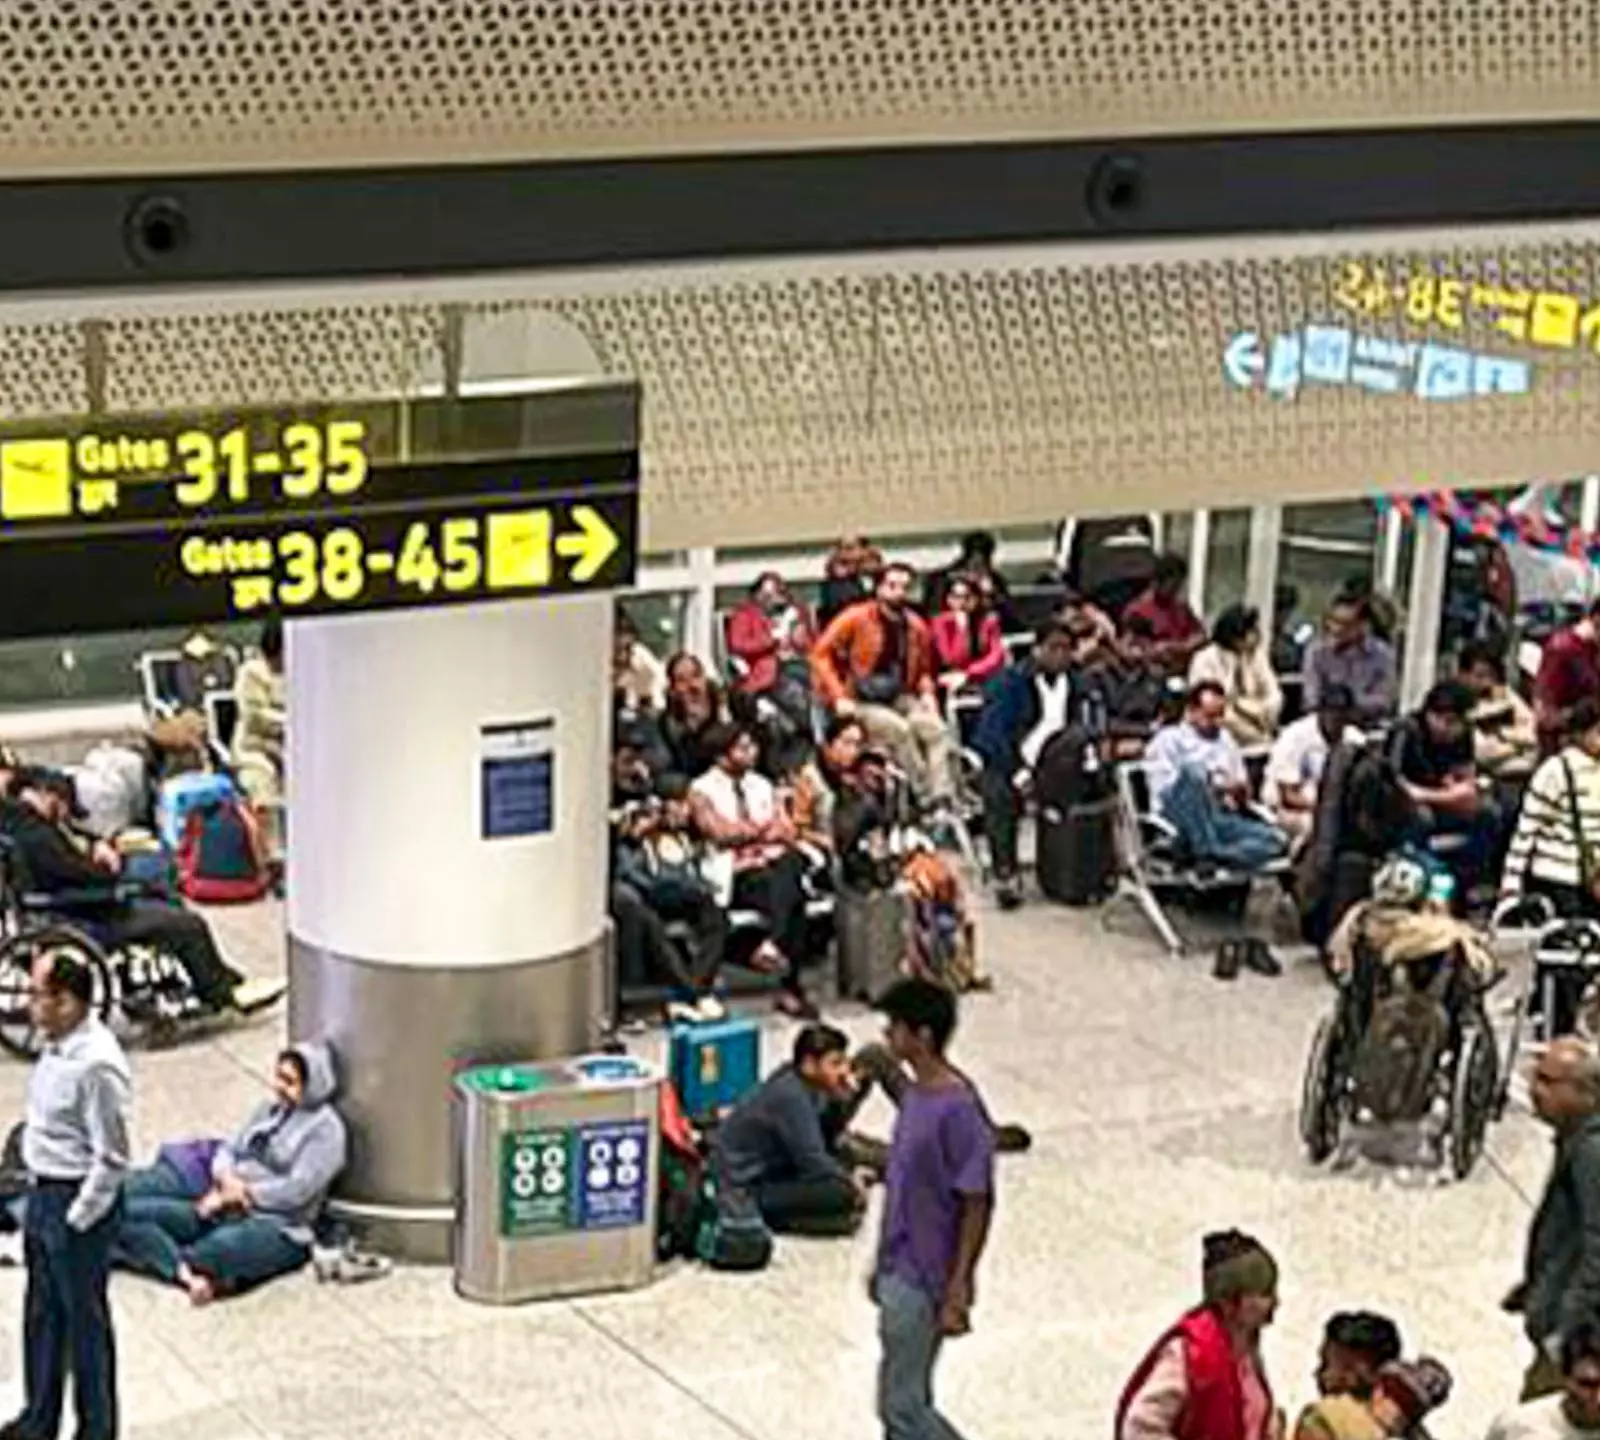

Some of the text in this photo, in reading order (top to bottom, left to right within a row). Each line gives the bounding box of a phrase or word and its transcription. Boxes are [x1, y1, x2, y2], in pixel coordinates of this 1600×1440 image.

[76, 434, 169, 473] Gates
[175, 421, 369, 505] 31-35
[180, 535, 273, 575] Gates
[276, 517, 480, 605] 38-45
